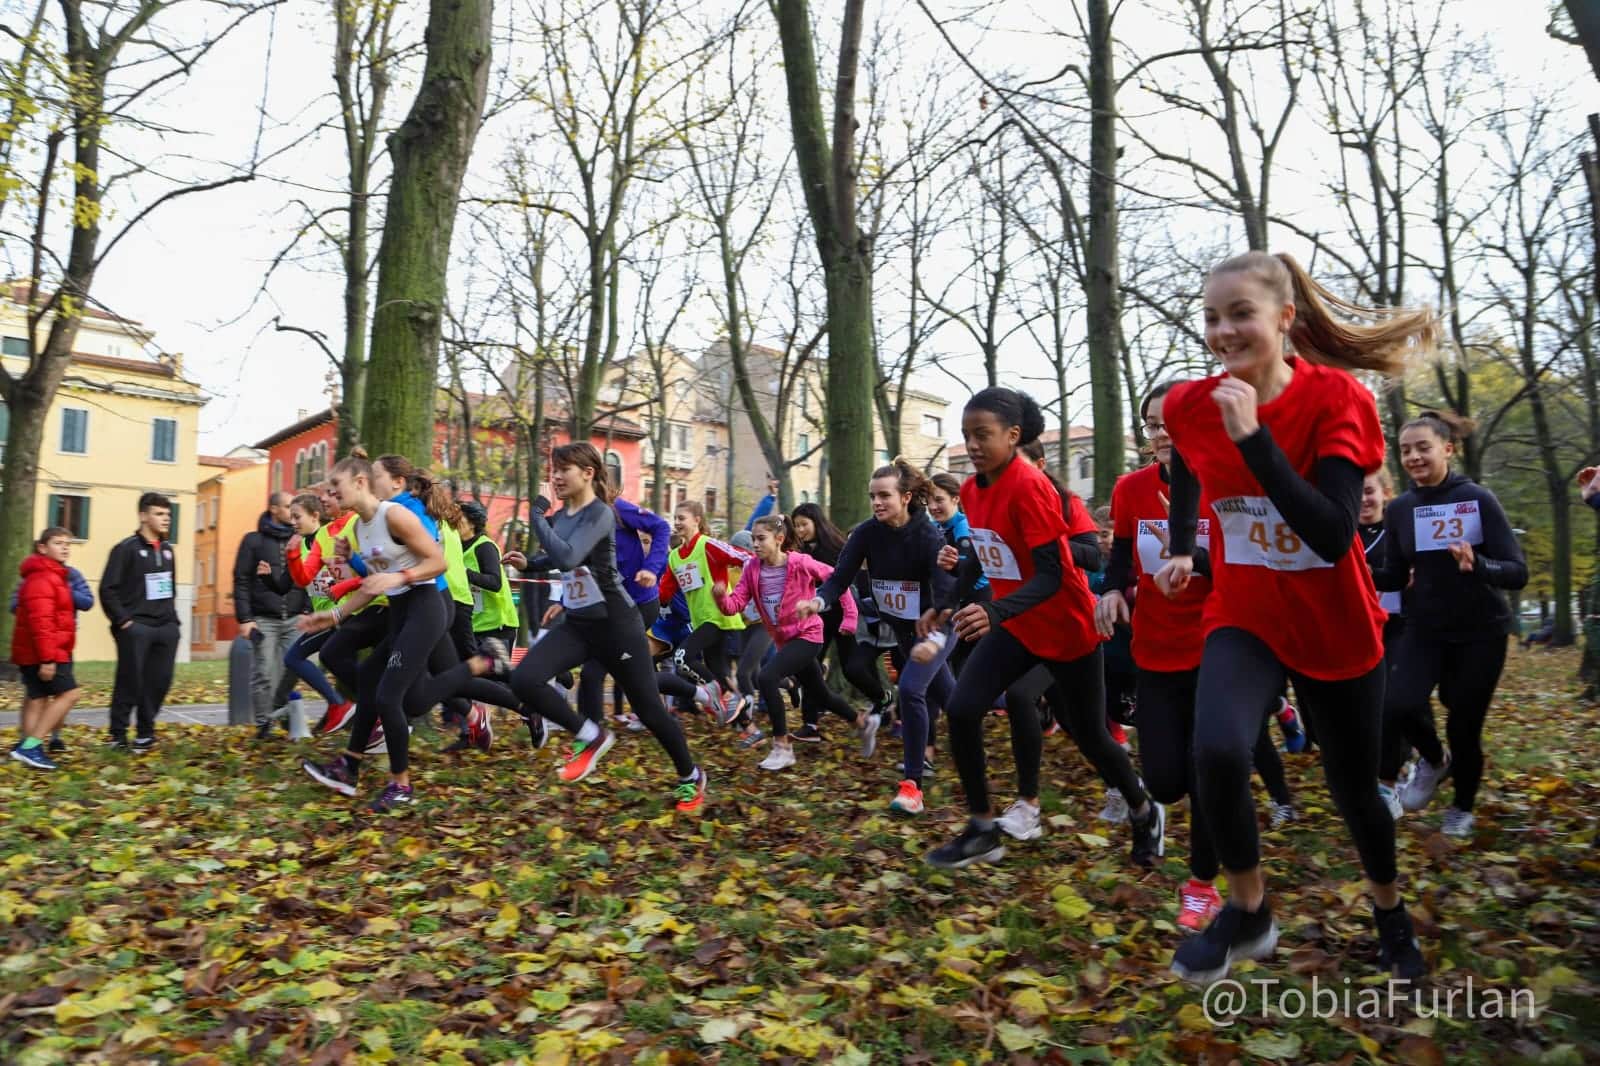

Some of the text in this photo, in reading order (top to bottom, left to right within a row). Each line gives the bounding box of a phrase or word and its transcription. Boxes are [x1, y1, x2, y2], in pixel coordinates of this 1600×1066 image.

[1248, 521, 1302, 554] 48
[1431, 517, 1464, 540] 23
[978, 544, 1004, 568] 49
[566, 580, 588, 601] 22
[679, 572, 693, 587] 53
[884, 592, 907, 611] 40
